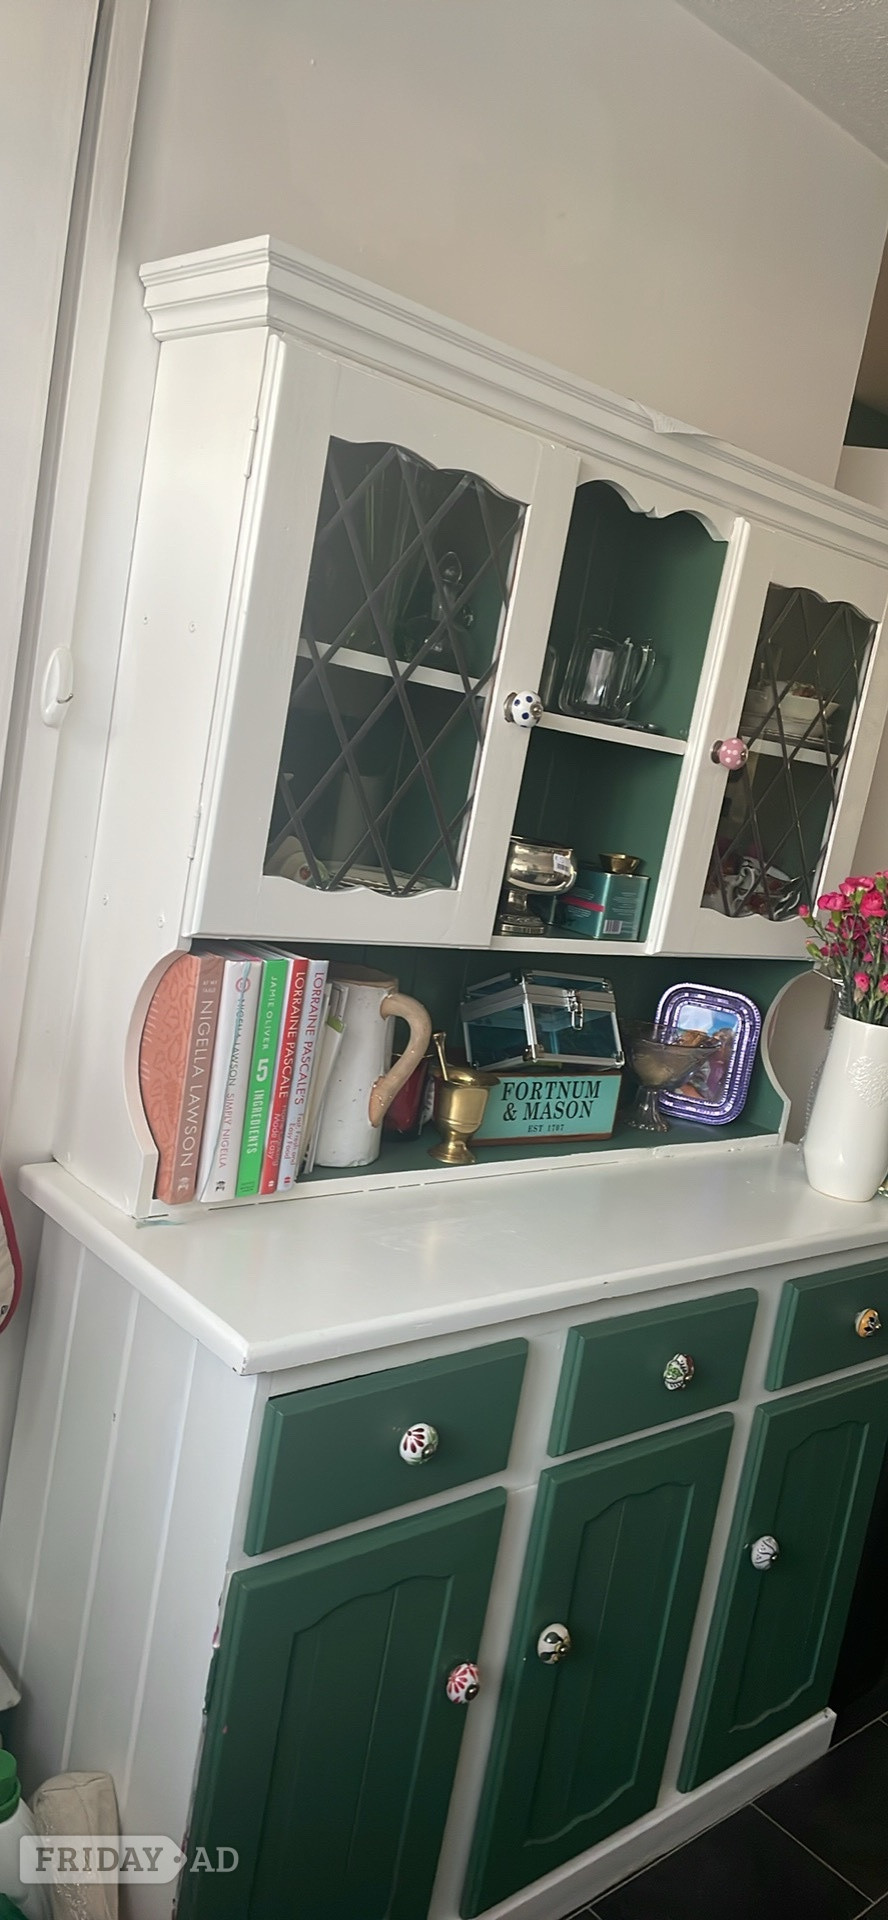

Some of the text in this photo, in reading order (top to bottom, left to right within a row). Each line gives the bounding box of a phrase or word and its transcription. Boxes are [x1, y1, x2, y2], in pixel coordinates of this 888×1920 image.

[262, 976, 278, 1050] JAMIE OLIVER
[279, 972, 306, 1098] LORRAINE PASCALE
[294, 972, 325, 1105] LORRAINE PASCALE'S
[180, 1000, 214, 1167] NIGELLA LAWSON
[228, 1042, 241, 1087] LAWSON
[501, 1080, 602, 1101] FORTNUM
[218, 1093, 235, 1169] SIMPLY NIGELLA
[247, 1058, 269, 1154] 5 INGREDIENTS
[502, 1100, 594, 1121] & MASON
[528, 1124, 544, 1132] EST
[267, 1113, 280, 1160] Made Easy
[284, 1122, 296, 1160] Easy Food
